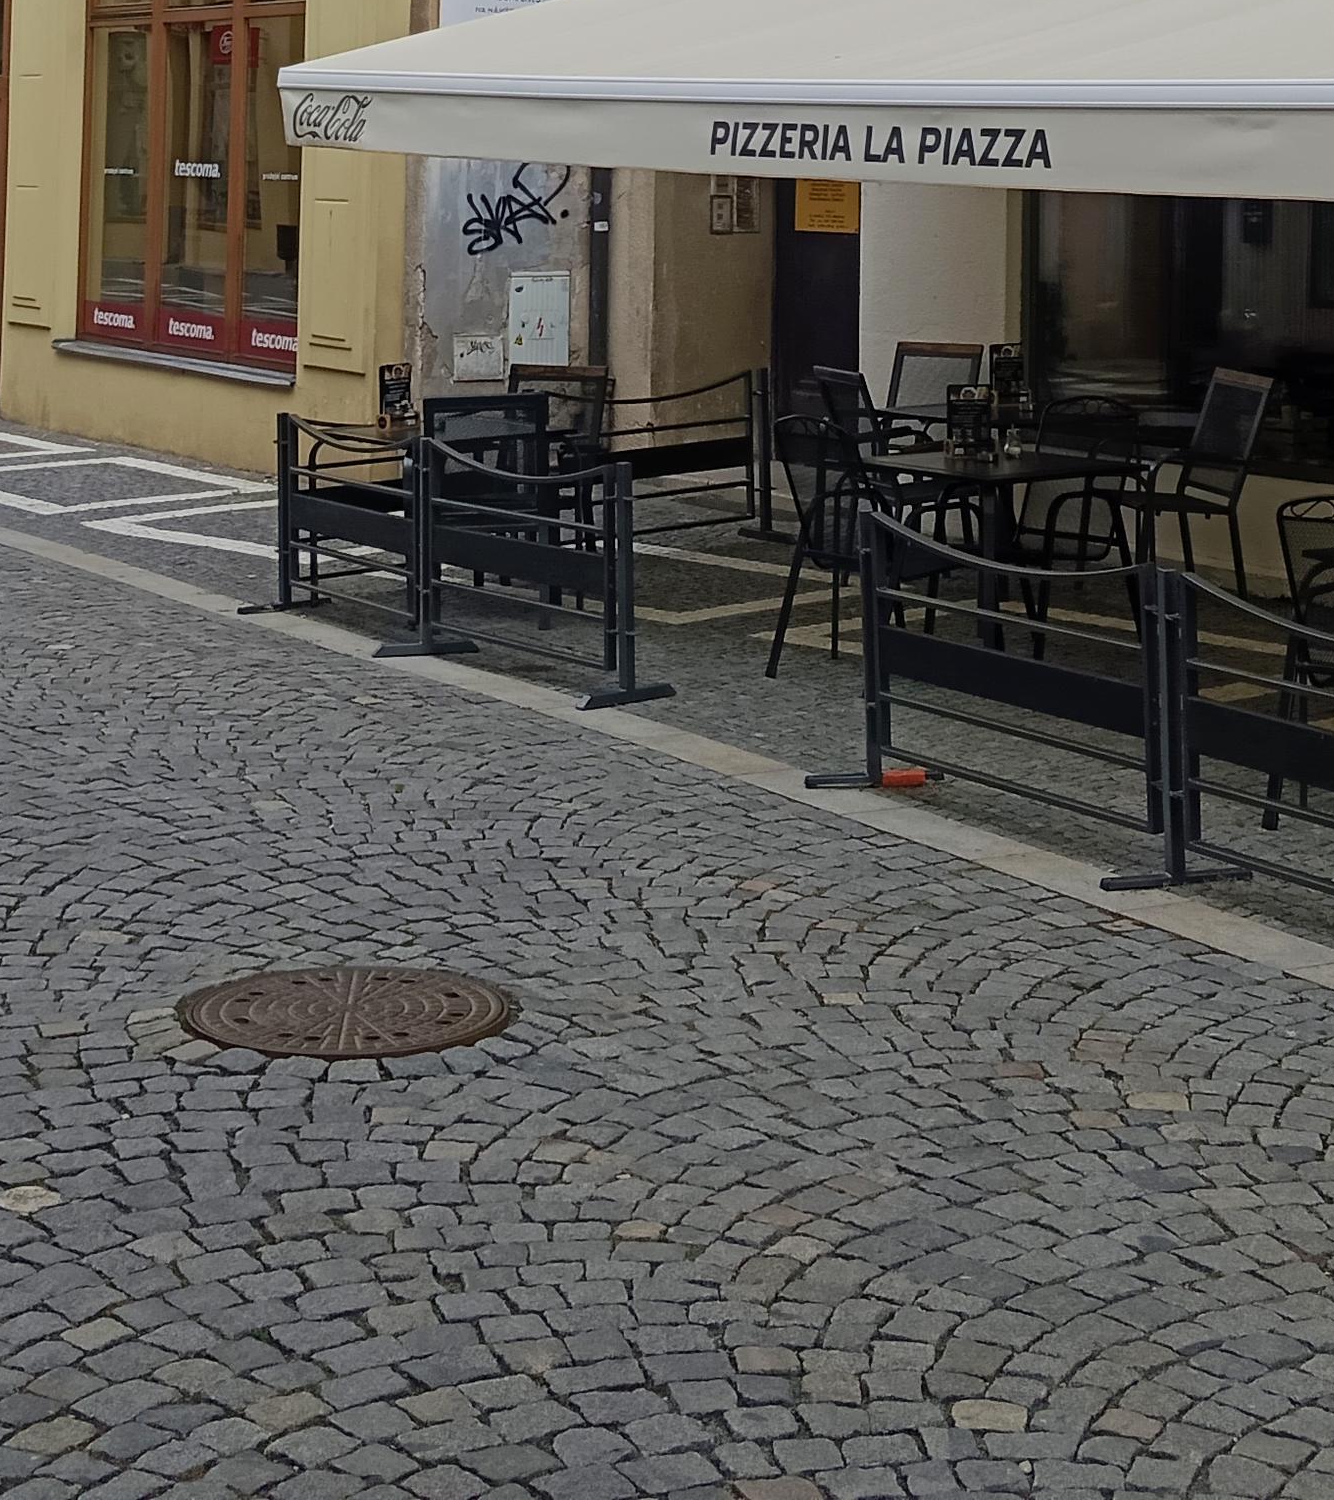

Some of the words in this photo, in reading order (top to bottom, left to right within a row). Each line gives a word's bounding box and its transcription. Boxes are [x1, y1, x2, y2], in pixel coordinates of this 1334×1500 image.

[292, 92, 373, 143] Coca-Cola
[709, 119, 853, 163] PIZZERIA
[863, 125, 907, 165] LA
[917, 127, 1054, 170] PIAZZA
